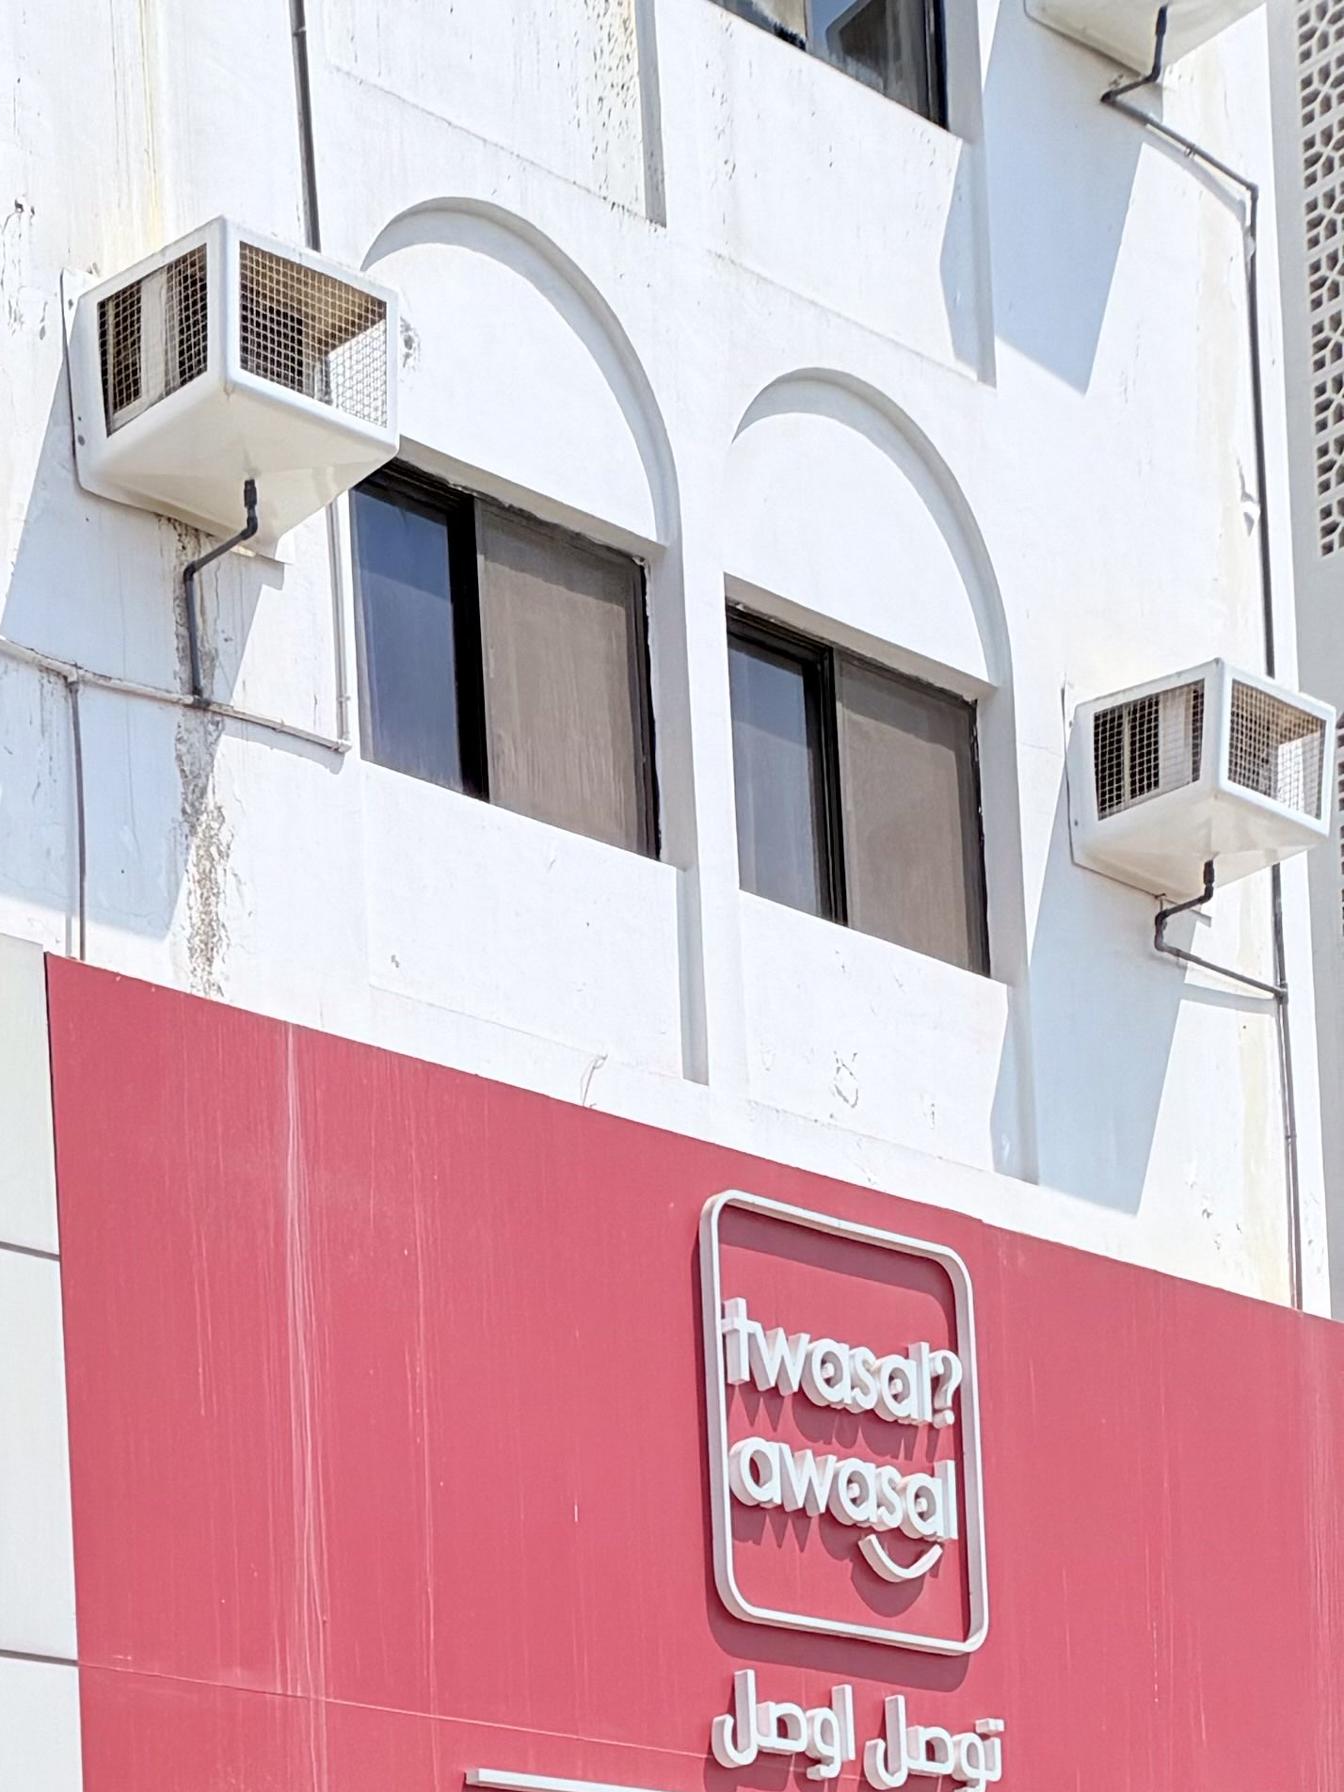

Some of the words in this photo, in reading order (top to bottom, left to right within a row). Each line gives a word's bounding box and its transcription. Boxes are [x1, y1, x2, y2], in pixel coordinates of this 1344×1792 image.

[721, 1296, 962, 1429] twasal?
[729, 1436, 958, 1541] awasal
[713, 1669, 855, 1781] اوصل
